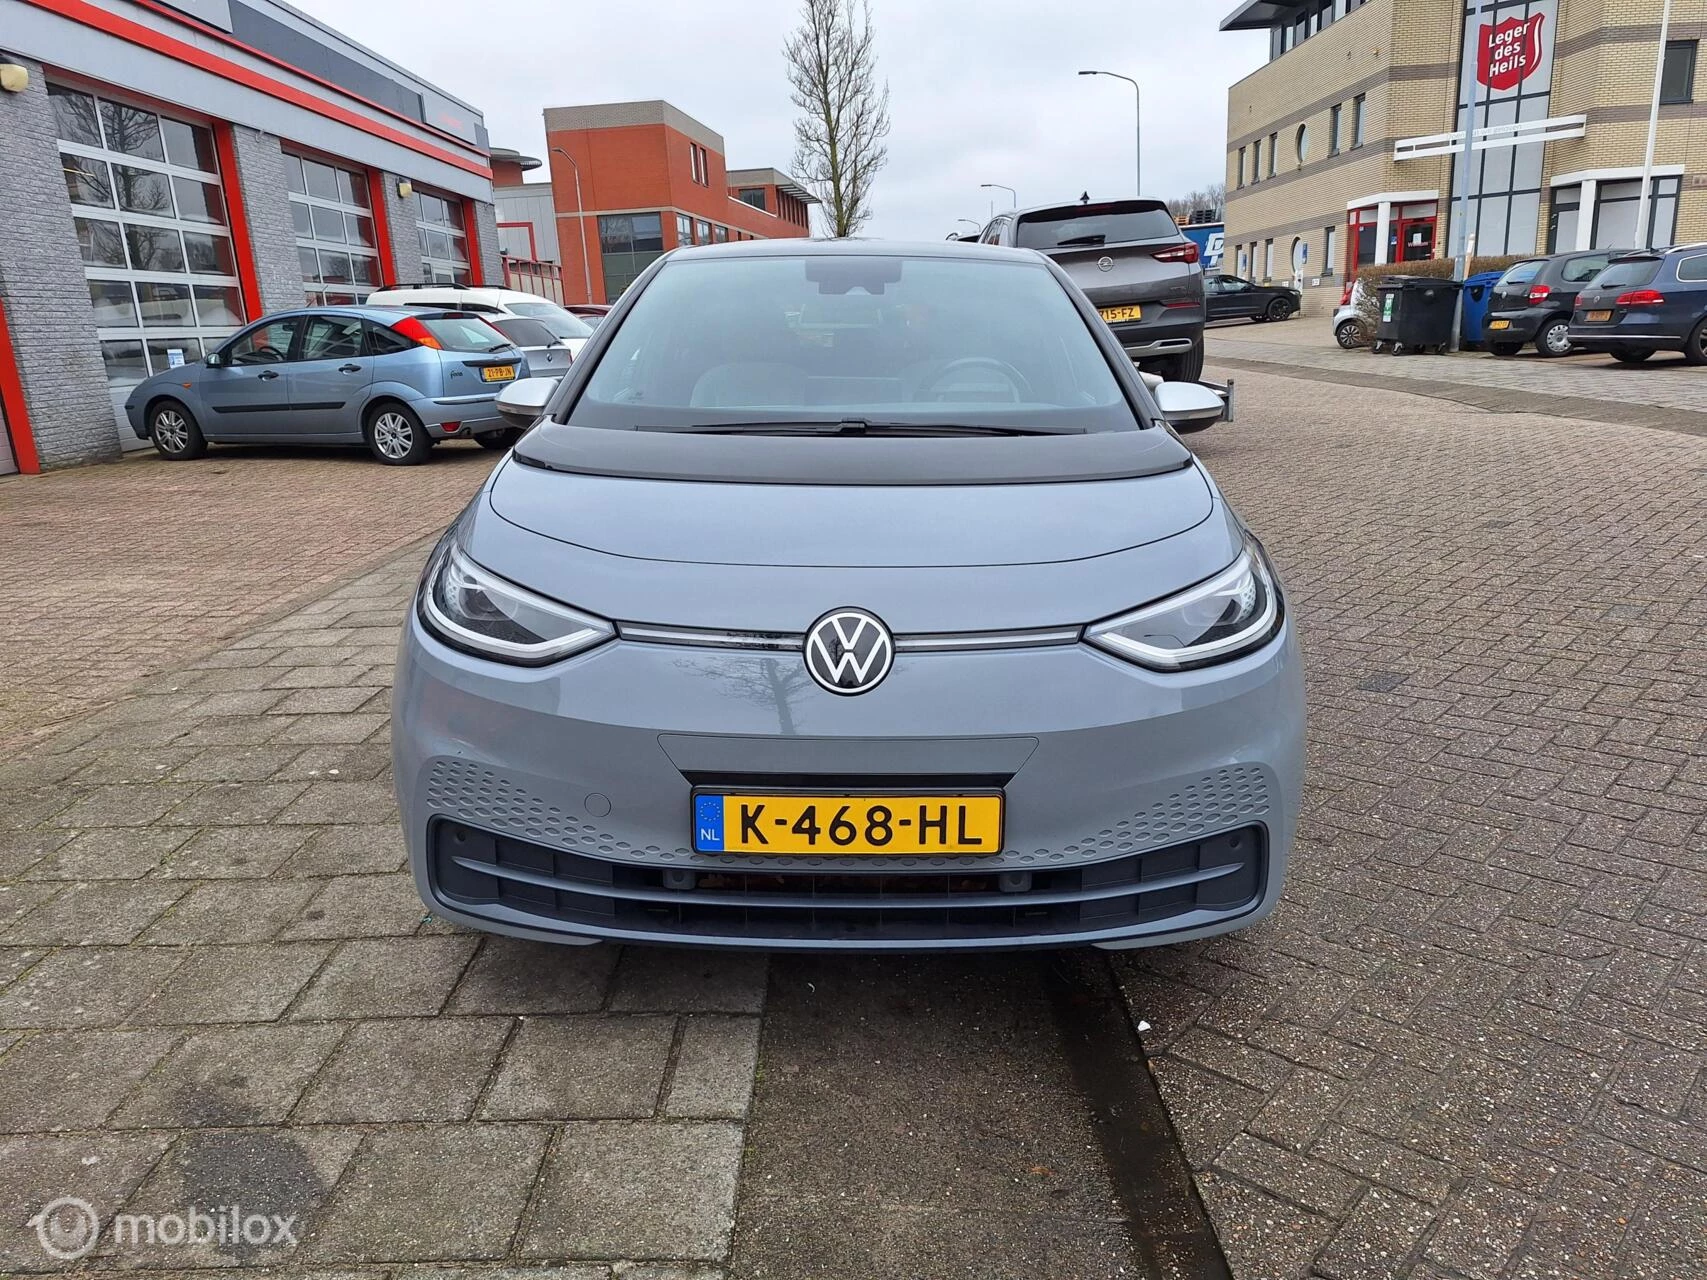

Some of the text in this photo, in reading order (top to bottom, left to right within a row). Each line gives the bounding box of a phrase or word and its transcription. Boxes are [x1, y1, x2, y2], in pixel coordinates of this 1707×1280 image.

[1488, 22, 1531, 48] Leger
[1494, 41, 1521, 60] des
[1489, 55, 1526, 77] Heils
[487, 367, 512, 378] 21-PB-JN
[700, 828, 720, 841] NL
[740, 804, 983, 846] K-468-HL
